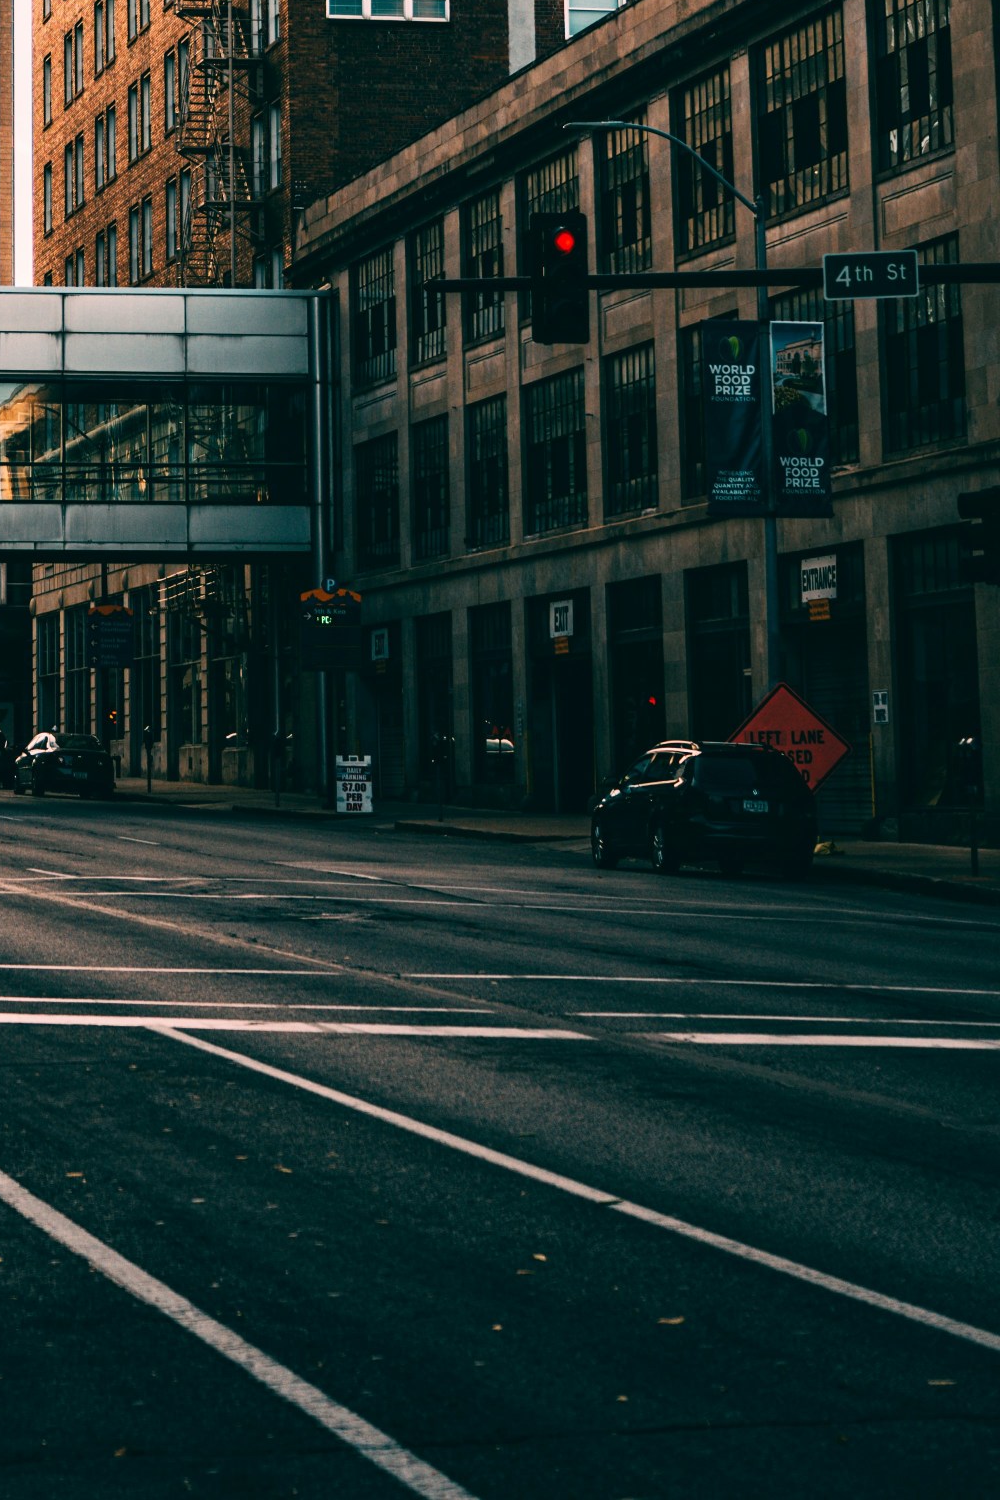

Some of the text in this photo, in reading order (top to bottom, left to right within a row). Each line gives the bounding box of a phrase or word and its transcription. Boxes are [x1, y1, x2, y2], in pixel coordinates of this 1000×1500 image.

[835, 263, 907, 287] 4th St
[709, 364, 755, 375] WORLD
[715, 375, 751, 385] FOOD
[715, 385, 751, 396] PRIZE
[780, 456, 824, 467] WORLD
[785, 467, 819, 478] FOOD
[785, 477, 821, 488] PRIZE
[802, 565, 836, 592] ENTRANCE
[327, 579, 336, 591] P
[554, 605, 569, 632] EXIT
[750, 730, 825, 745] LEFT LANE
[342, 782, 367, 792] $7.00
[346, 792, 363, 801] PER
[346, 802, 363, 811] DAY
